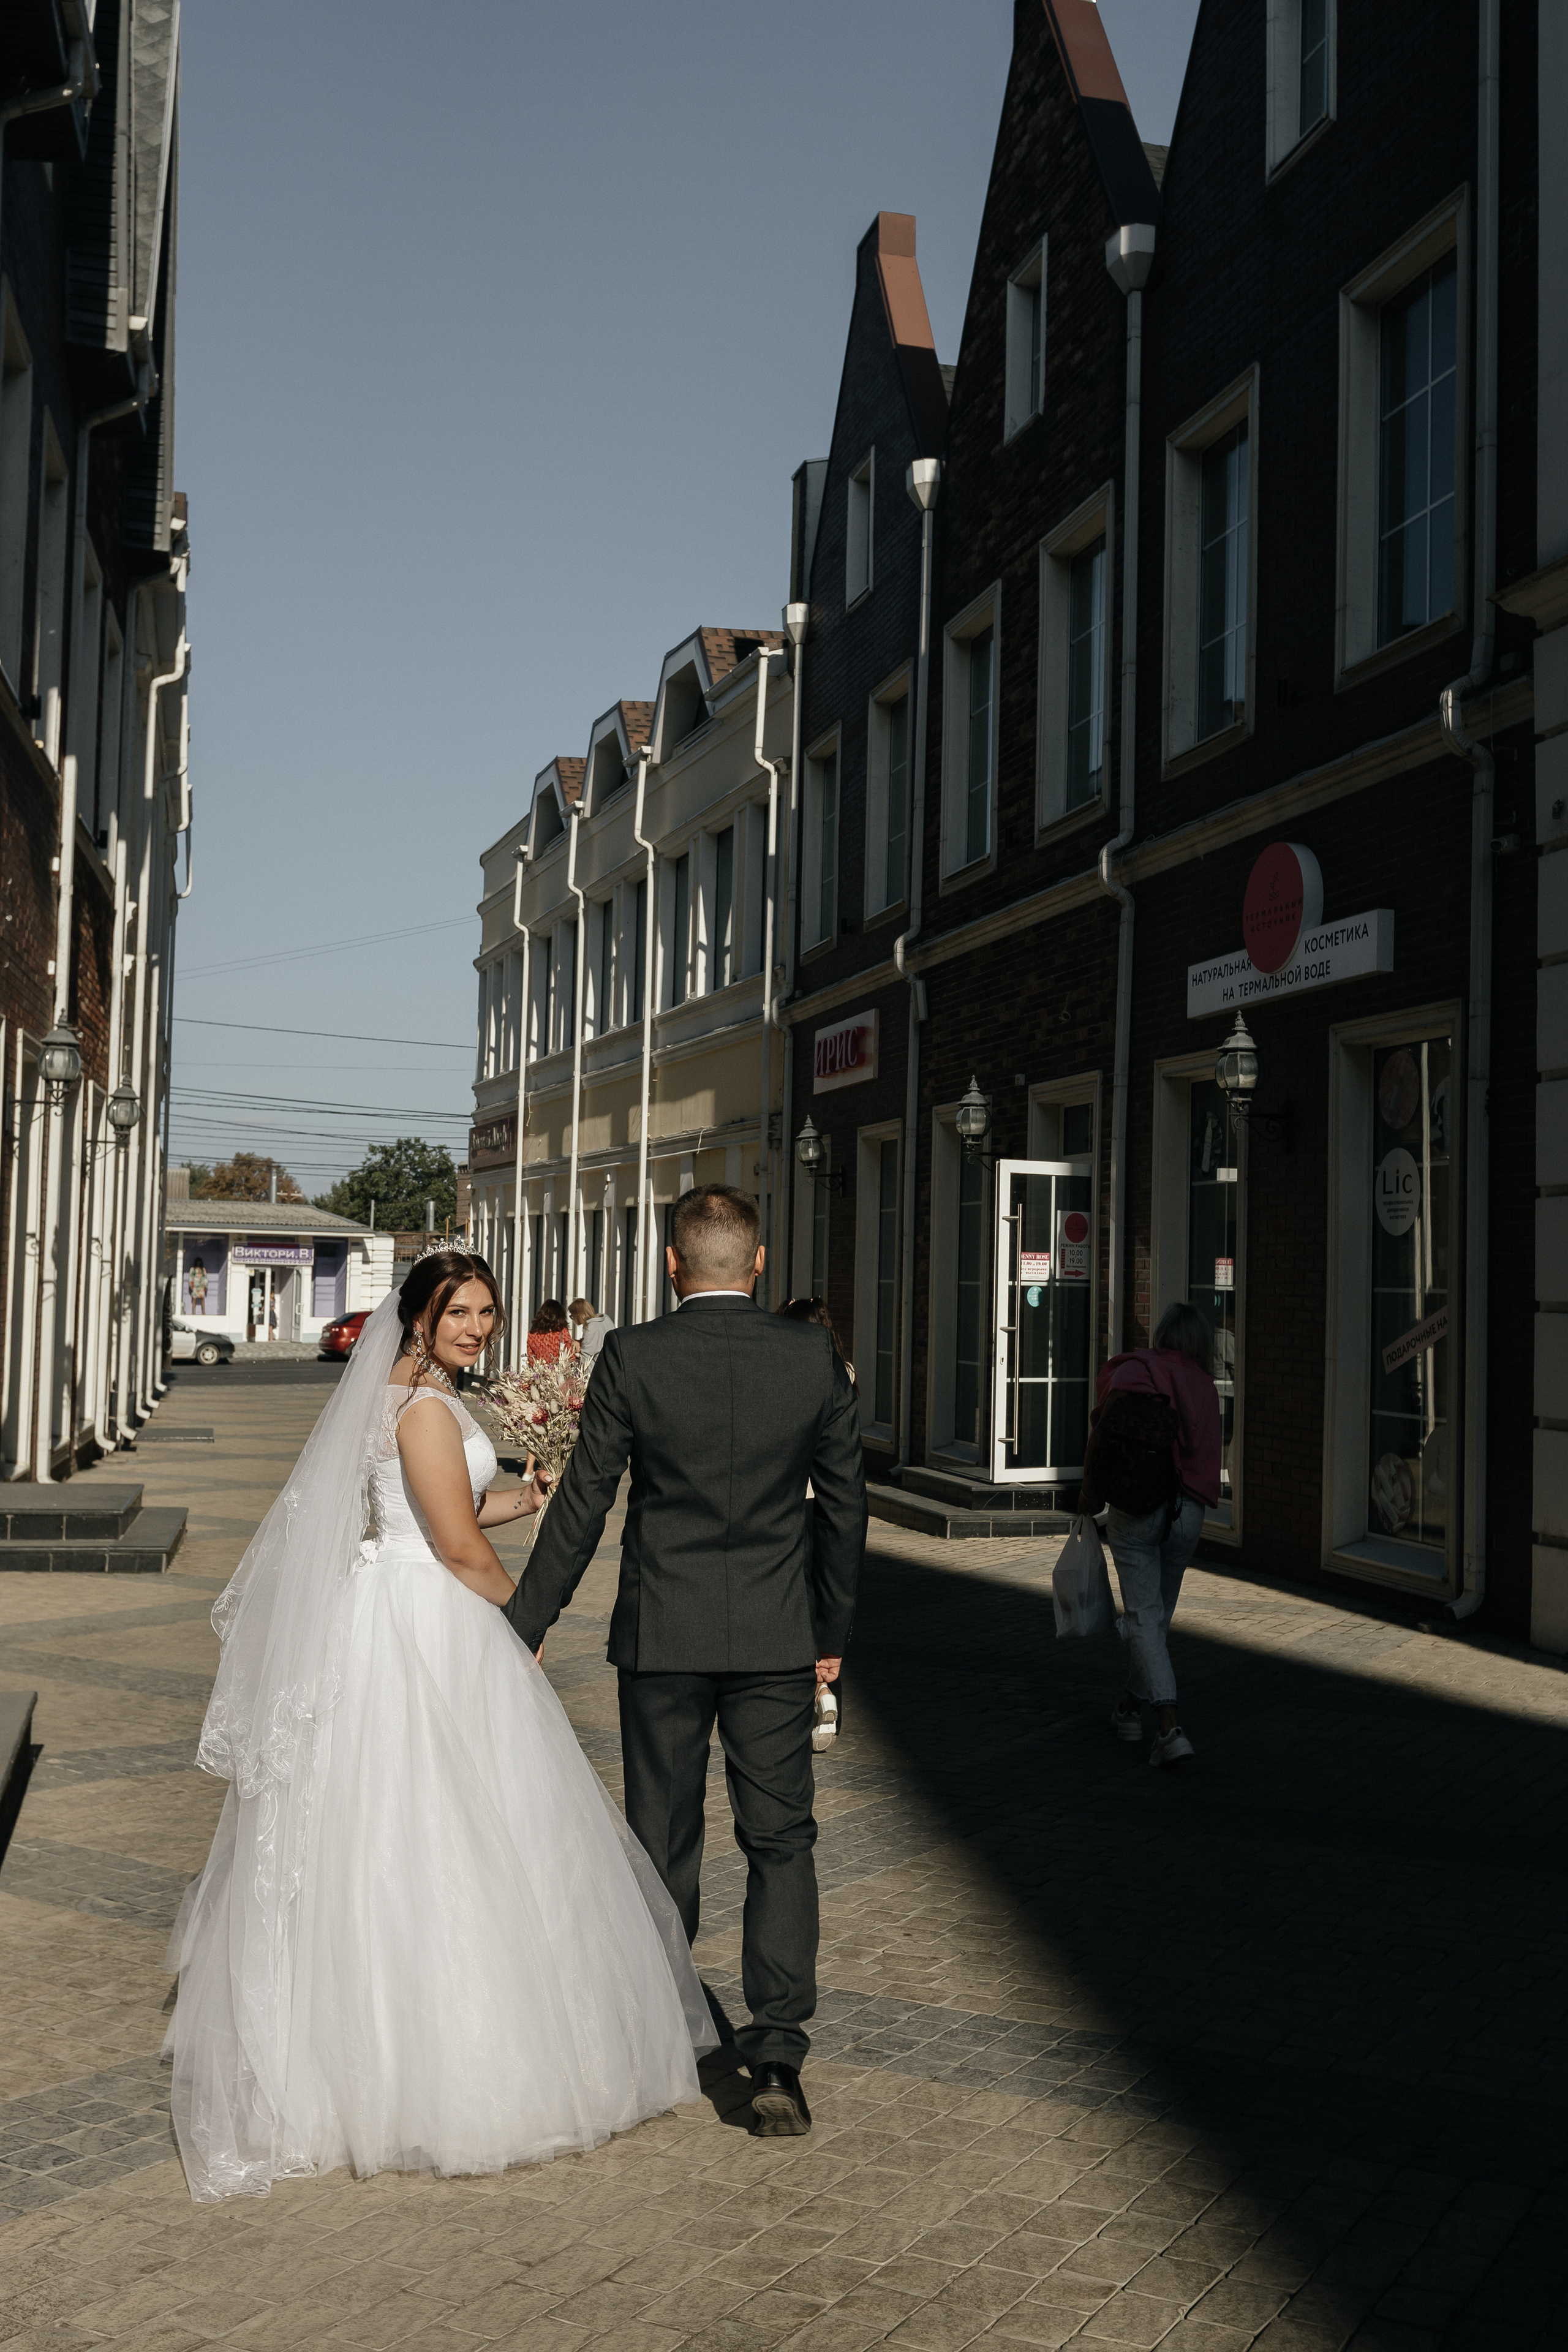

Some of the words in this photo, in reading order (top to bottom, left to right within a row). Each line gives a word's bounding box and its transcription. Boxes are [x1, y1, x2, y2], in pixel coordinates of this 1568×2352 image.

[1246, 896, 1302, 923] ТЕРМАЛЬНЫЙ
[1251, 913, 1295, 933] ИСТОЧНИК
[1192, 957, 1252, 987] НАТУРАЛЬНАЯ
[1304, 922, 1369, 954] КОСМЕТИКА
[1223, 987, 1235, 1002] НА
[1238, 965, 1302, 998] ТЕРМАЛЬНОЙ
[1304, 959, 1331, 981] ВОДЕ
[814, 1027, 860, 1077] ИРИС
[1382, 1168, 1412, 1194] Lic
[1386, 1323, 1436, 1366] ПОДАРОЧНЫЕ
